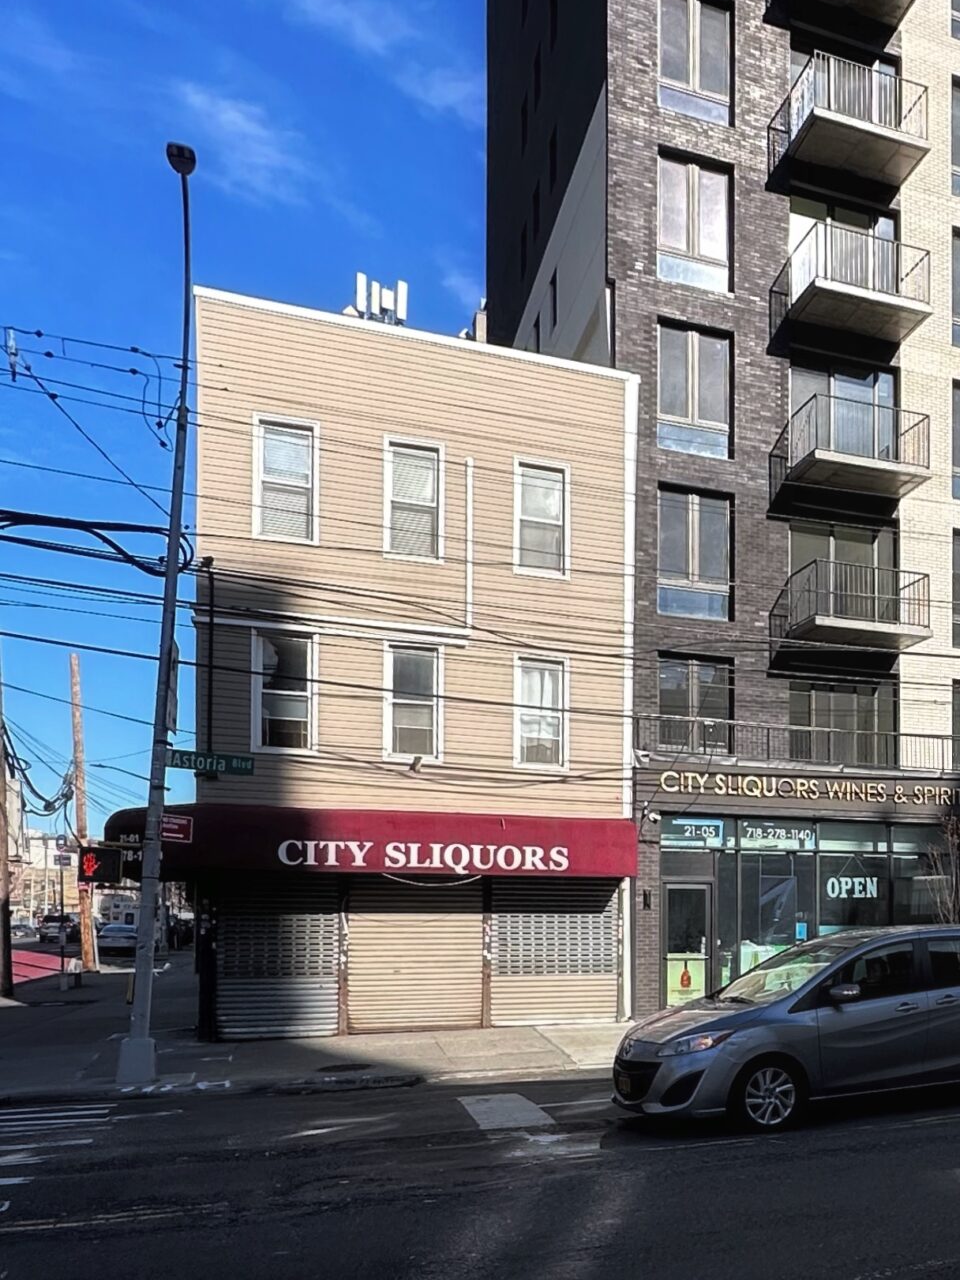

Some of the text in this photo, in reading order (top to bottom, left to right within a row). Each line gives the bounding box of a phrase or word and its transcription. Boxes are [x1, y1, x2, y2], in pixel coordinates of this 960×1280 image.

[173, 753, 252, 771] Astoria Blvd
[660, 771, 710, 794] CITY
[714, 774, 819, 800] SLIQUORS
[825, 781, 887, 803] WINES
[894, 785, 908, 804] &
[684, 826, 715, 838] 21-05
[746, 826, 811, 840] 718-278-1140
[278, 839, 570, 874] CITY SLIQUORS
[826, 876, 879, 899] OPEN
